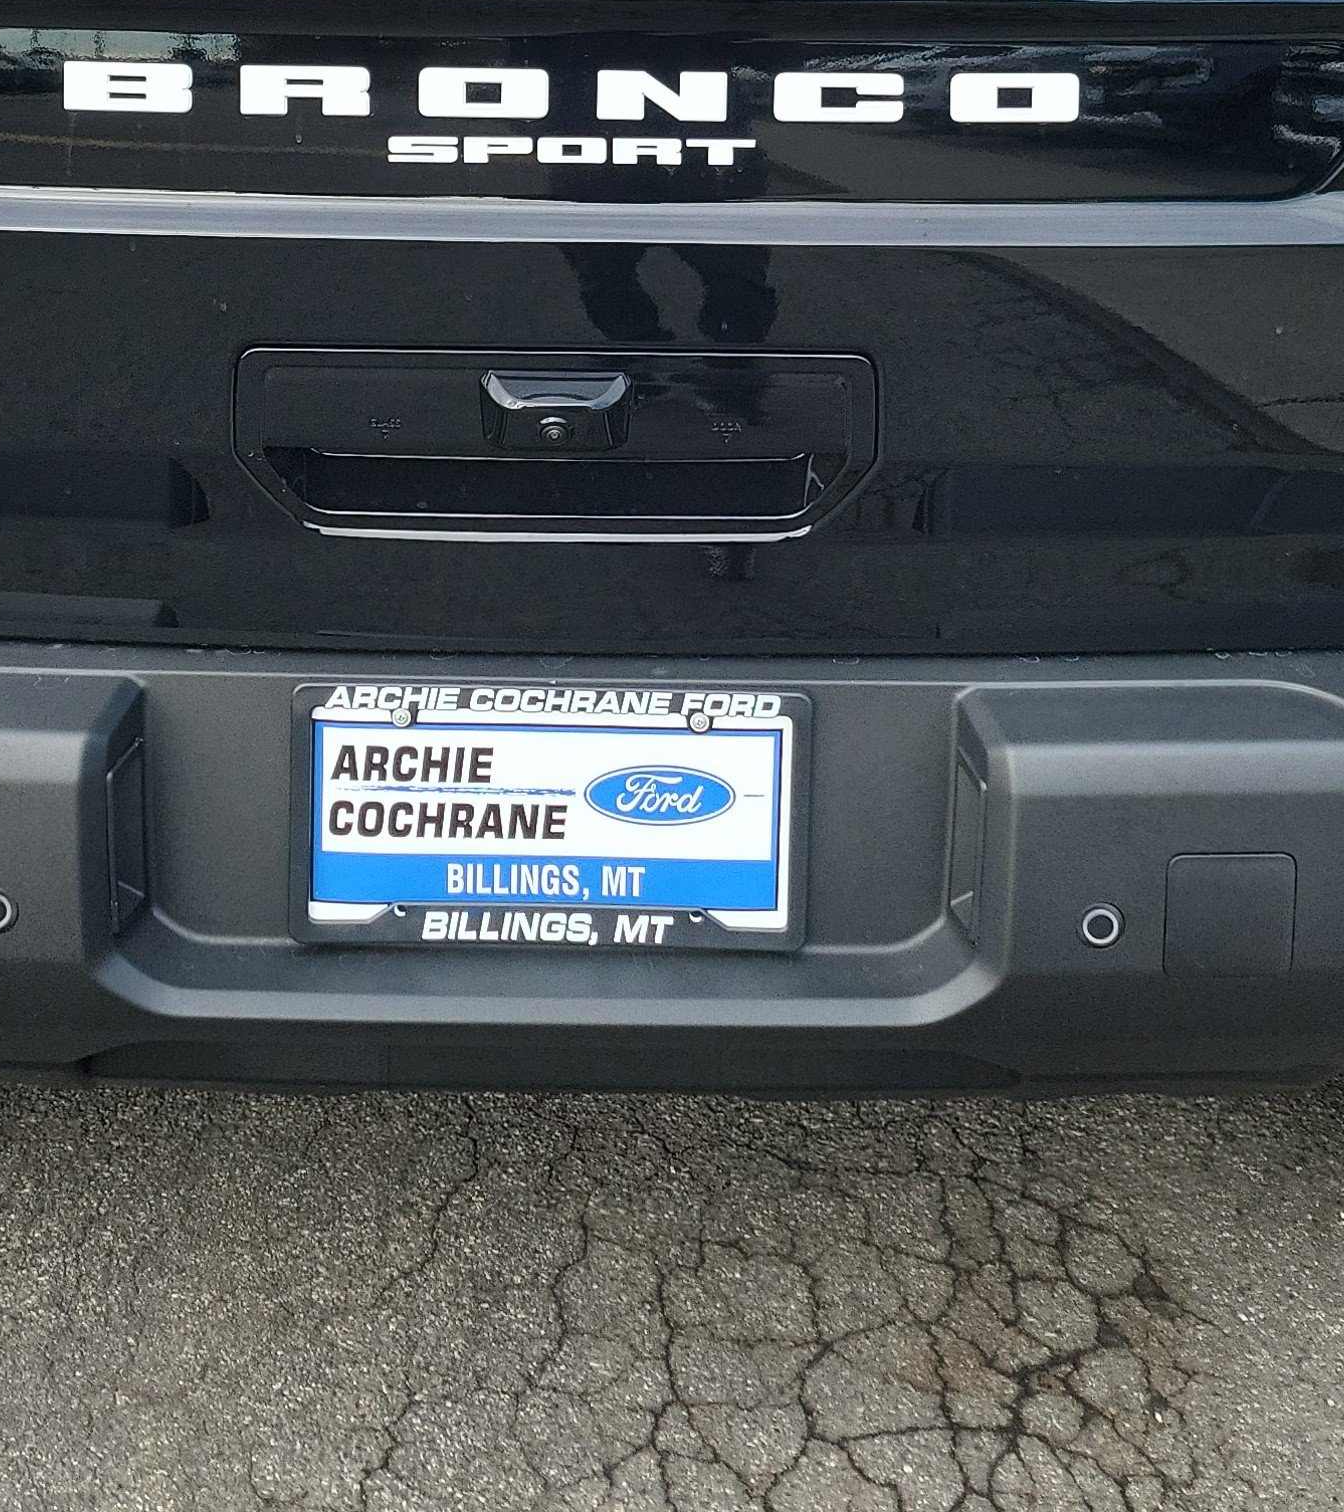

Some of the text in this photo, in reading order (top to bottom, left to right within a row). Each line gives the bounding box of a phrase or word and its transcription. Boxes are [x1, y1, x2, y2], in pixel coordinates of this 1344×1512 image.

[63, 60, 1080, 123] BRONCO
[387, 135, 756, 165] SPORT
[325, 685, 781, 719] ARCHIE COCHRANE FORD
[330, 744, 495, 783] ARCHIE
[615, 771, 702, 815] Ford
[328, 800, 568, 841] COCHRANE
[446, 863, 646, 900] BILLINGS, MT
[422, 910, 674, 947] BILLINGS, MT
